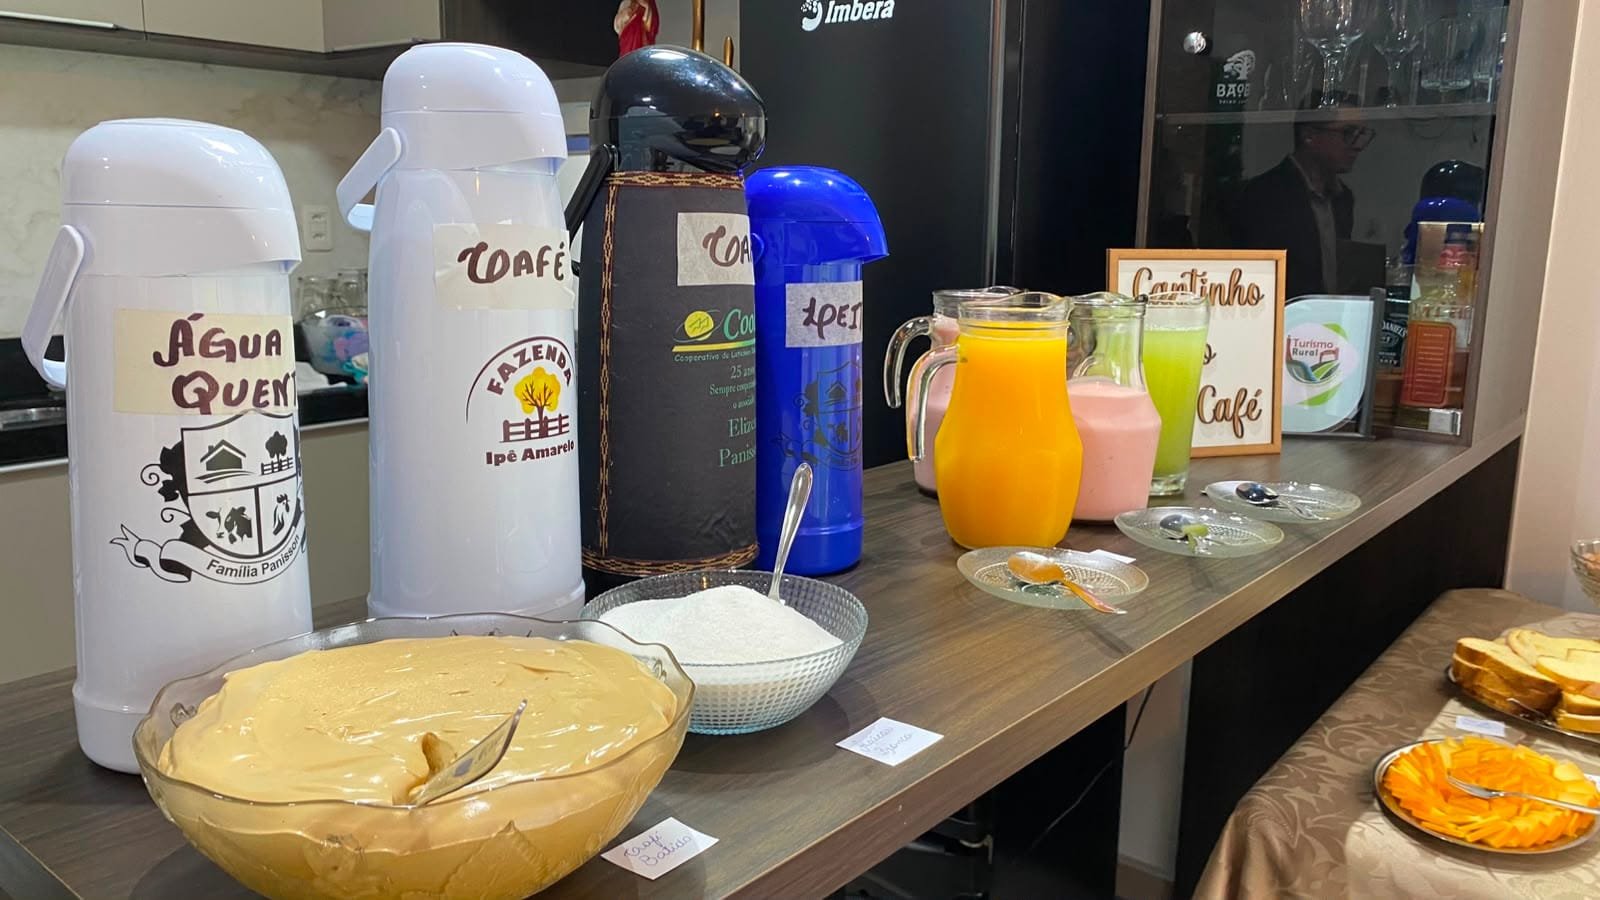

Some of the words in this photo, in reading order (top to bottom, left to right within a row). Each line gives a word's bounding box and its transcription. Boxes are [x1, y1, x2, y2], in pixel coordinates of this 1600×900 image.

[824, 0, 895, 24] Imbera
[1132, 267, 1265, 306] Cantinho
[153, 313, 282, 367] ÁGUA
[723, 308, 755, 340] Coo
[1292, 348, 1319, 356] Rural
[1293, 338, 1334, 349] Turismo
[487, 344, 573, 396] FAZENDA
[730, 364, 742, 379] 25
[1196, 384, 1263, 439] Café
[486, 449, 517, 466] Ipê
[521, 440, 575, 461] Amarelo
[206, 559, 258, 577] Família
[261, 535, 300, 575] Panisson
